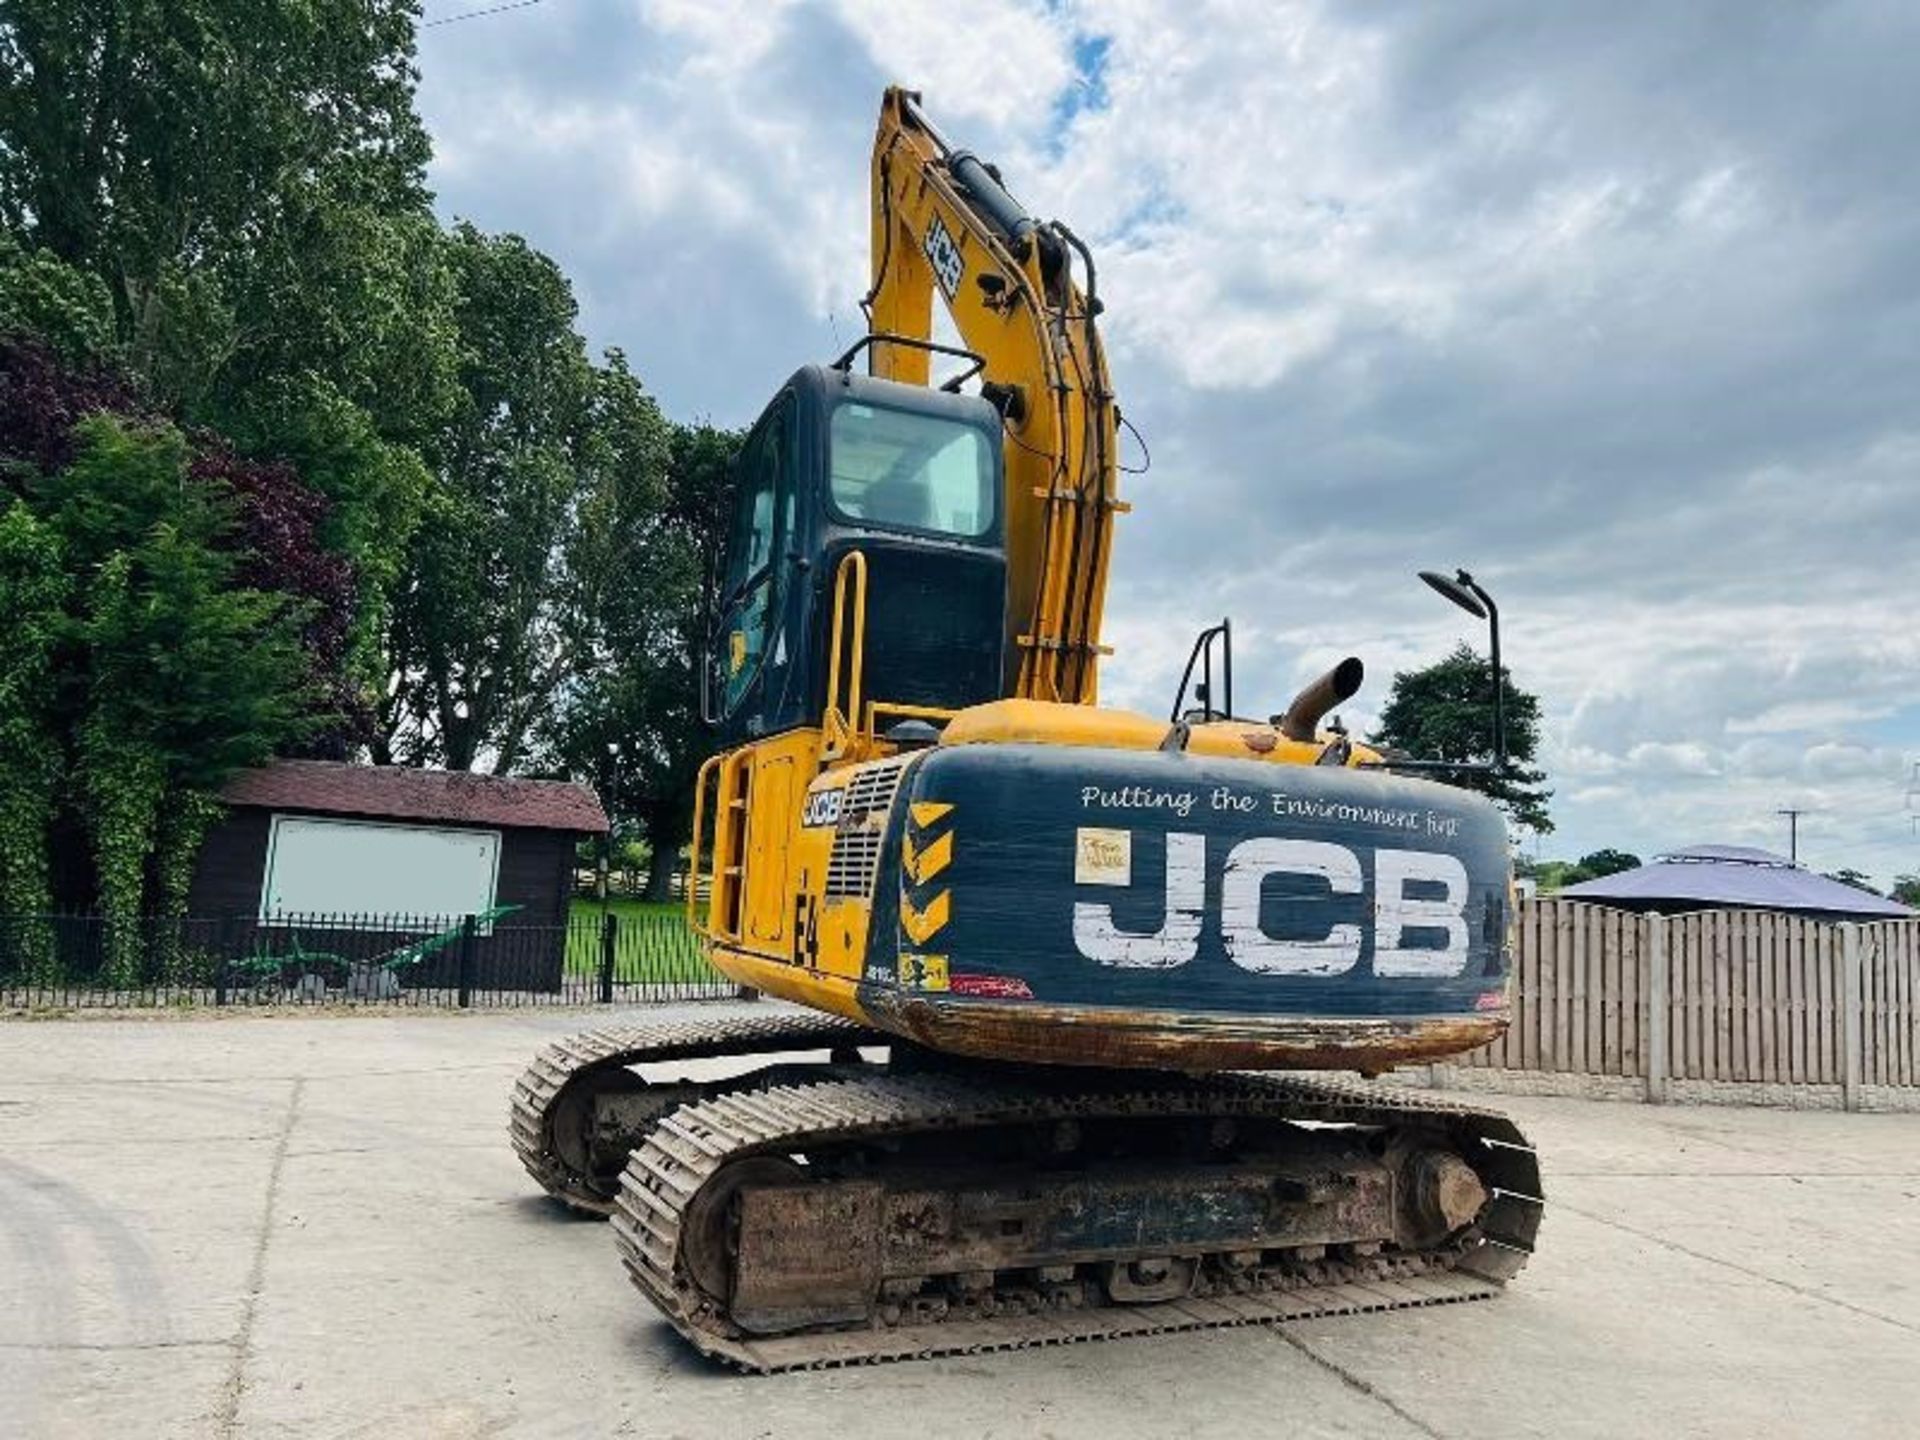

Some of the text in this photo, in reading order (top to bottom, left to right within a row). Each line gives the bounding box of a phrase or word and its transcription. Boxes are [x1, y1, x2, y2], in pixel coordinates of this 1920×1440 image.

[925, 213, 963, 297] JCB
[803, 789, 843, 826] JCB
[1081, 785, 1199, 817] Putting
[1210, 786, 1258, 813] the
[1271, 793, 1419, 829] Environment
[793, 894, 819, 967] E4
[1072, 831, 1470, 978] JCB
